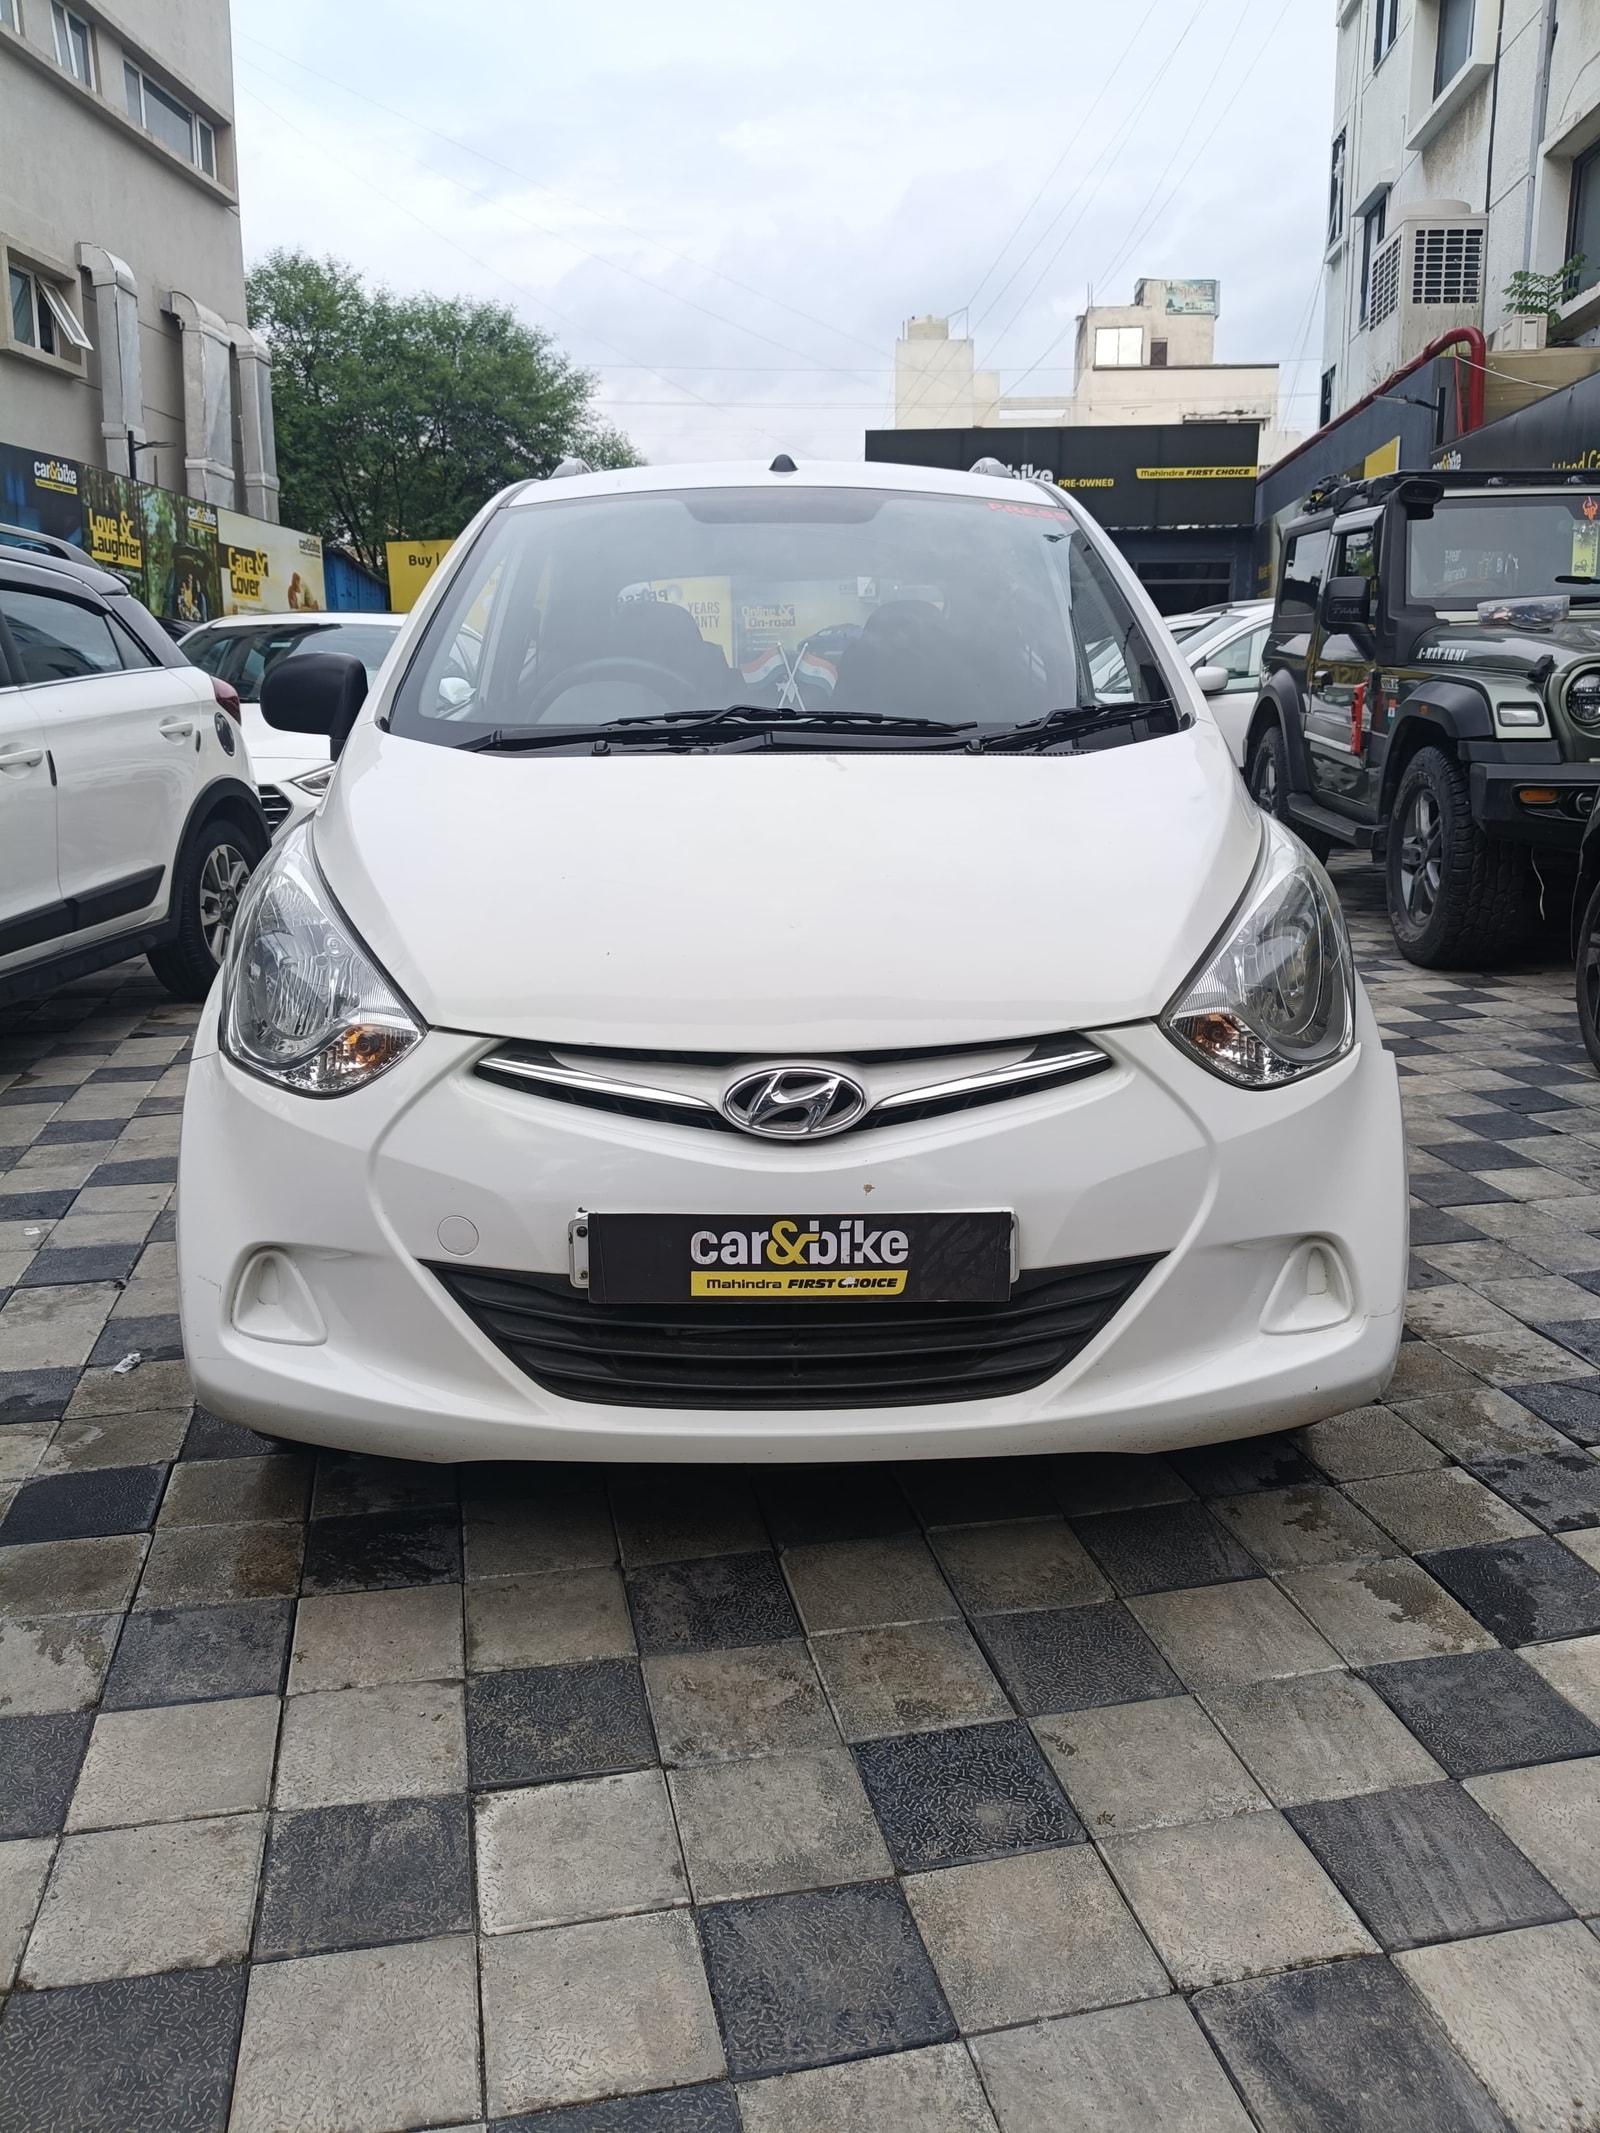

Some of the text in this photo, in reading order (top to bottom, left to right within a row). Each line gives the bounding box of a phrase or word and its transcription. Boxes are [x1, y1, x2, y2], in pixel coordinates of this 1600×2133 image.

[34, 460, 77, 485] car&bike
[1140, 467, 1250, 477] Mahindra FIRST CHOICE
[1058, 478, 1114, 488] PRE-OWNED
[89, 508, 134, 539] Love &
[93, 530, 141, 561] Laughter
[228, 546, 268, 577] Care &
[408, 554, 433, 568] Buy
[230, 570, 260, 597] Cover
[687, 601, 720, 614] YEARS
[748, 616, 796, 627] On-road
[690, 1220, 909, 1265] car&bike
[706, 1278, 782, 1289] Mahindra
[787, 1278, 836, 1289] FIRST
